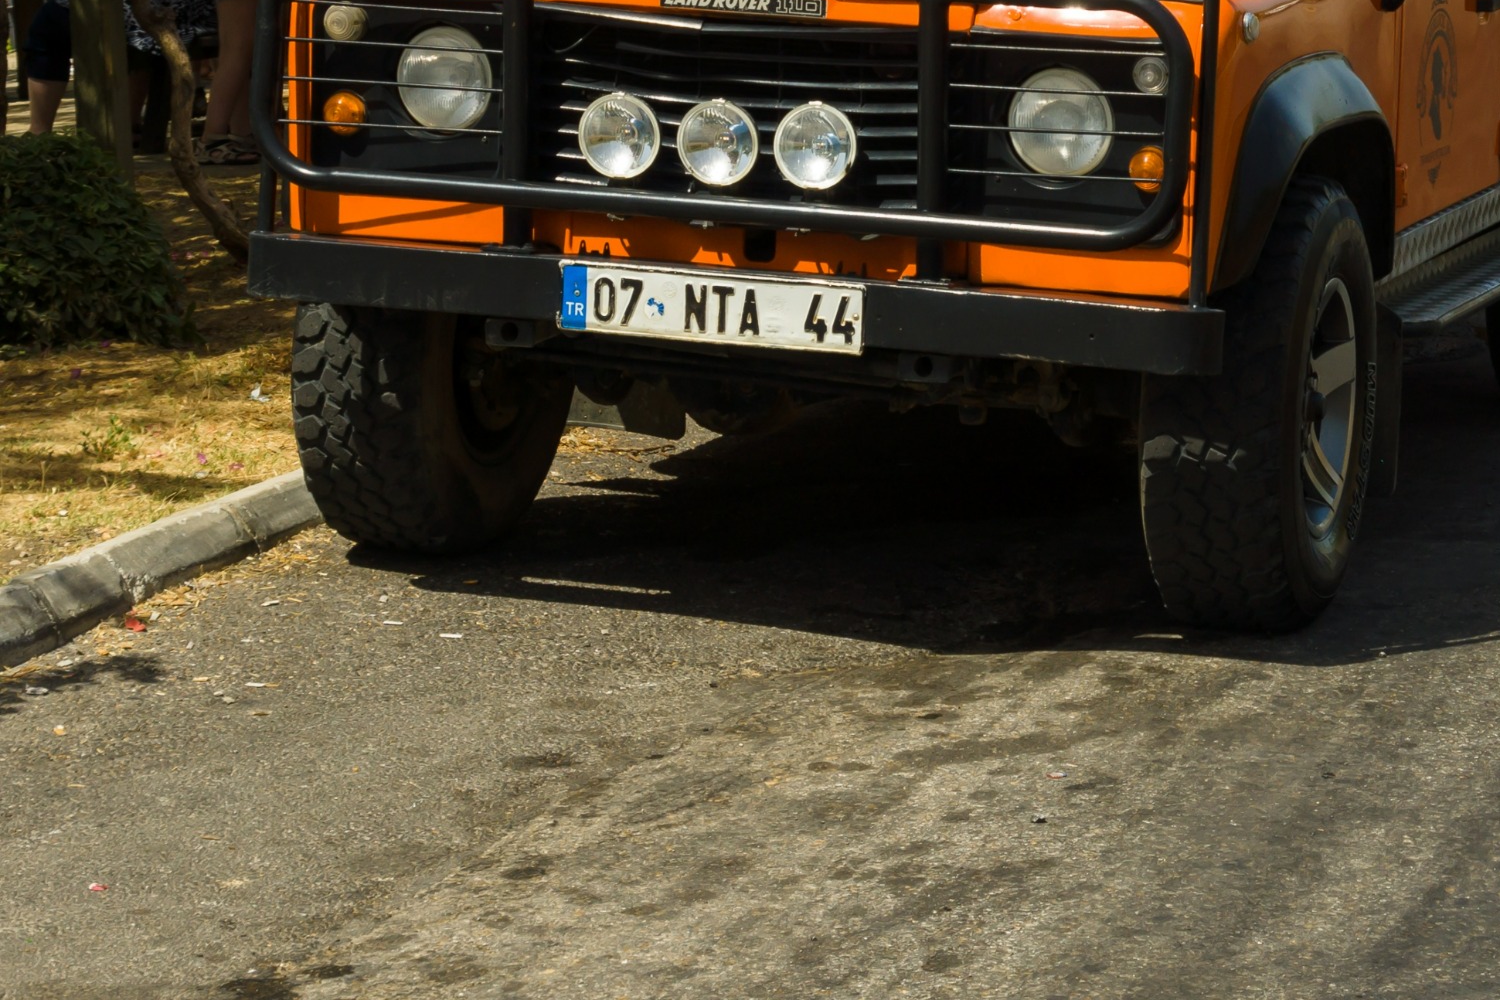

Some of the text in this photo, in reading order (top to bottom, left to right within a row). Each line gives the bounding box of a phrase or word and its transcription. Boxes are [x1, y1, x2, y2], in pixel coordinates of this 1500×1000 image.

[565, 301, 585, 317] TR
[592, 276, 857, 345] 07 NTA 44
